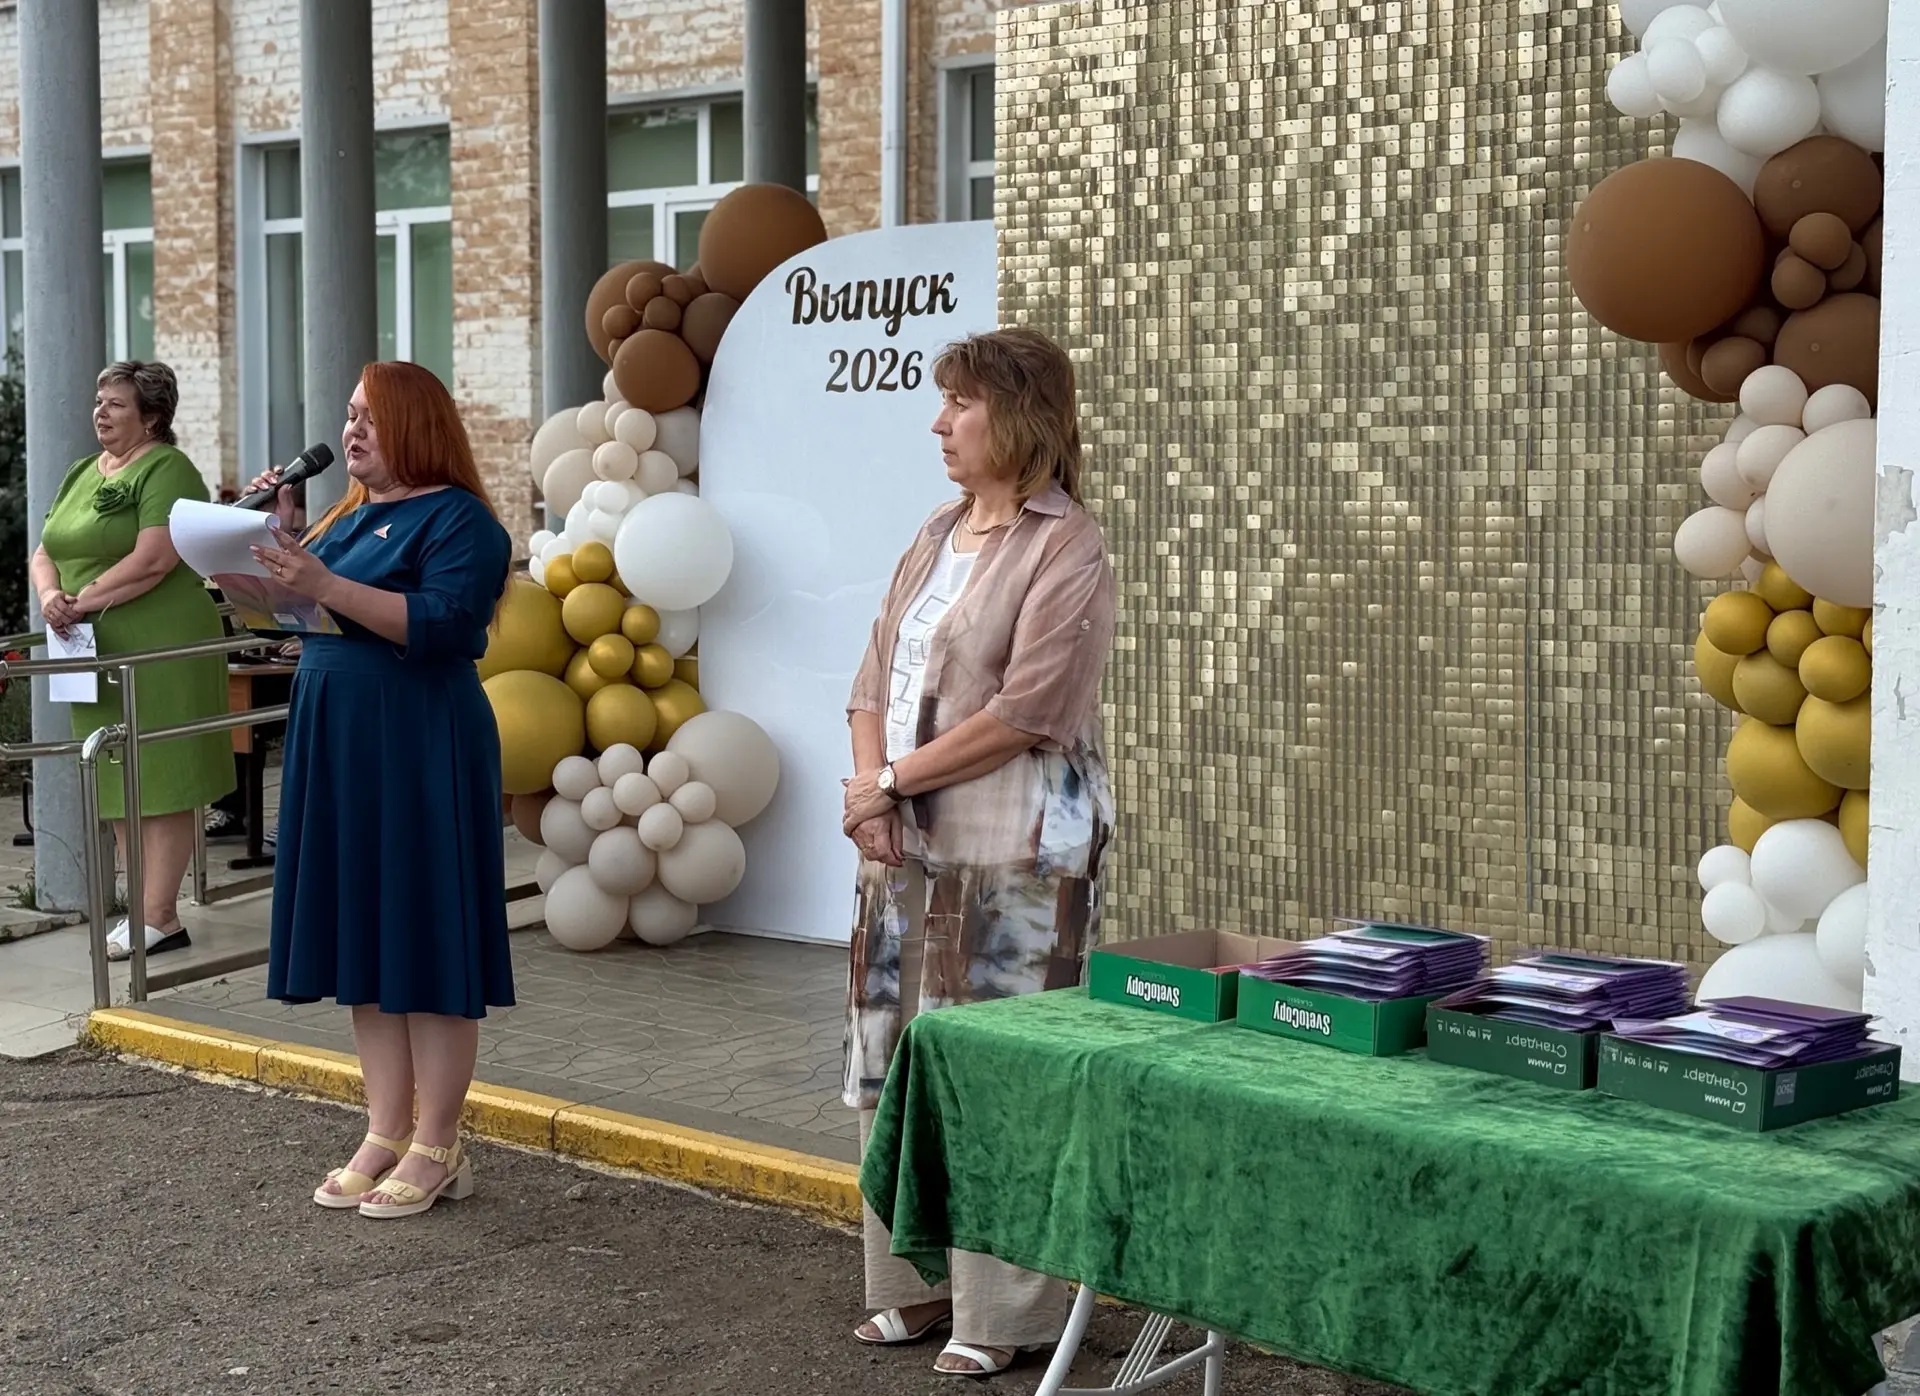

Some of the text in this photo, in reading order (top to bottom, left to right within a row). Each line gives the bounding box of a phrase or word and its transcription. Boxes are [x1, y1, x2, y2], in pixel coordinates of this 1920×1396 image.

[785, 266, 958, 337] Выпуск
[825, 348, 923, 393] 2026
[1125, 975, 1181, 1008] SvetoCopy
[1286, 996, 1313, 1007] CLASSIC
[1272, 999, 1332, 1036] SvetoCopy
[1505, 1034, 1567, 1058] Стандарт
[1682, 1067, 1748, 1096] Стандарт
[1854, 1061, 1894, 1081] Стандарт
